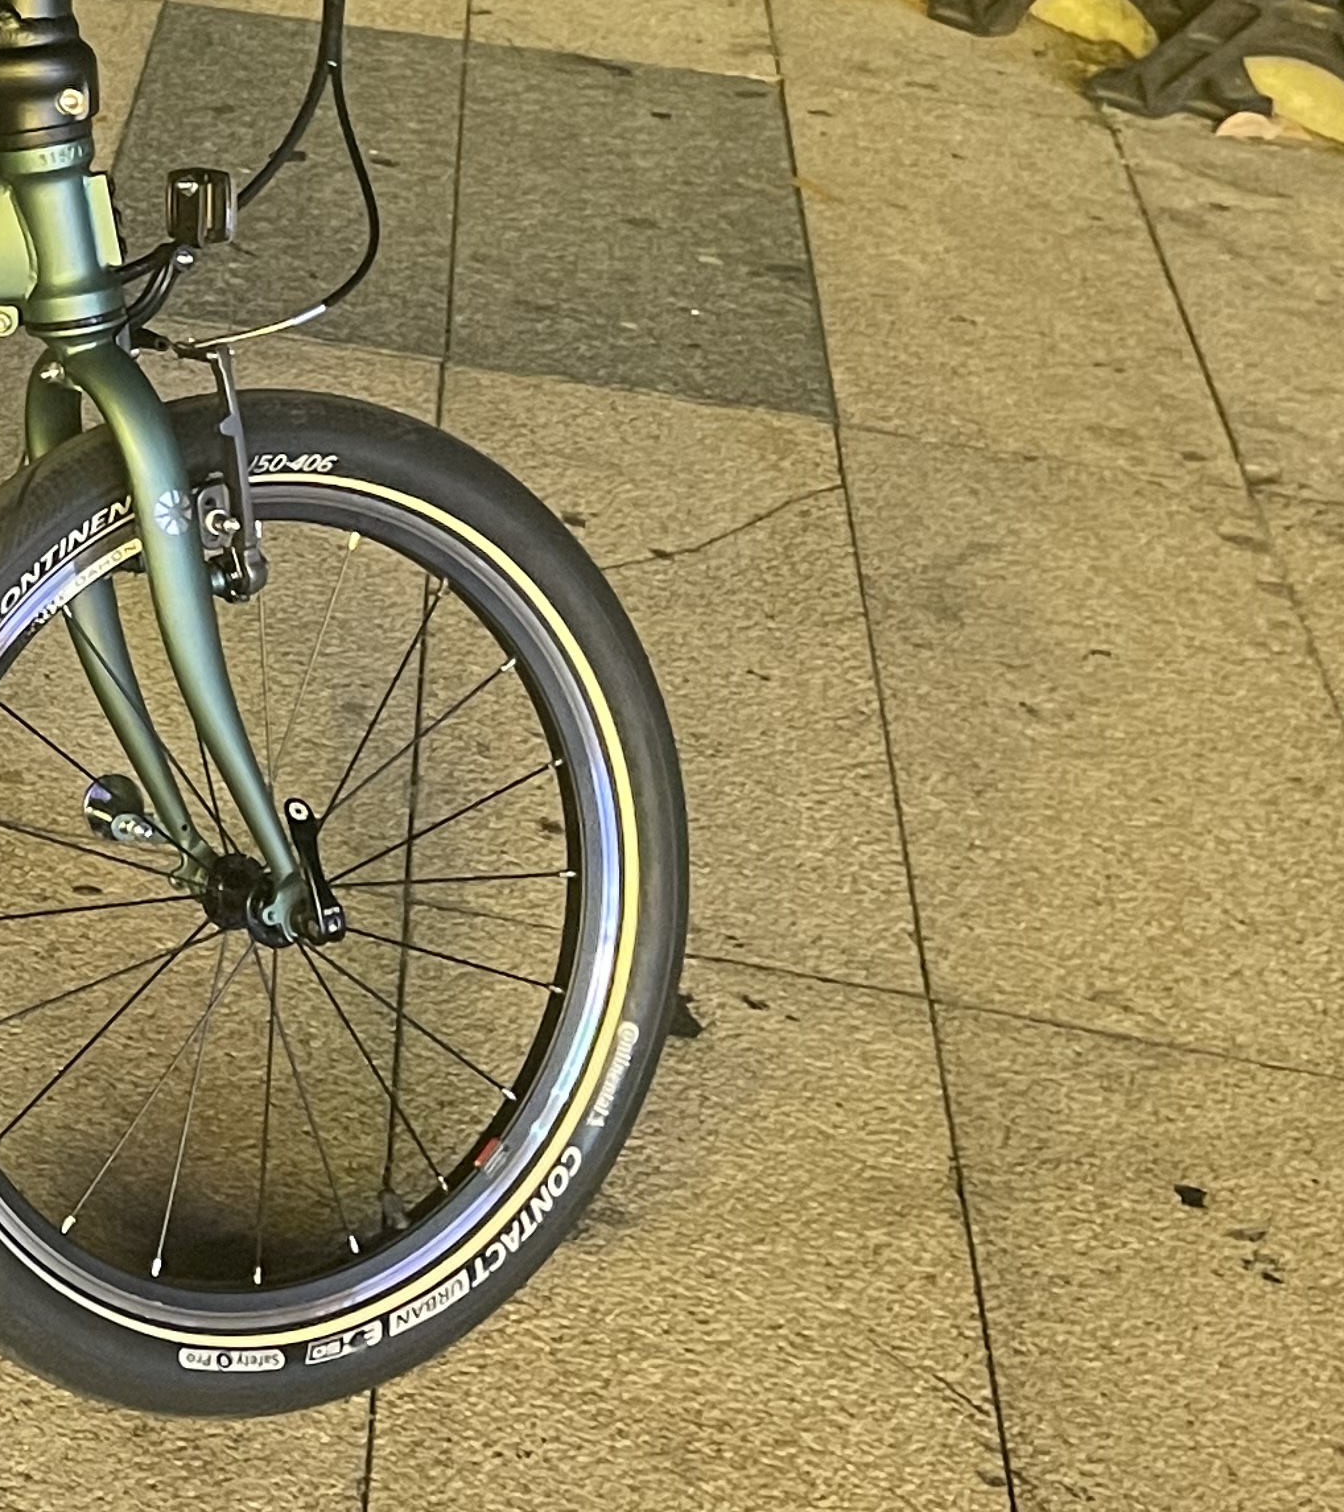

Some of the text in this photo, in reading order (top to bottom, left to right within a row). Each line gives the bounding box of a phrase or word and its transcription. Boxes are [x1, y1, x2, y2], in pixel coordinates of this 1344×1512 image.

[471, 1145, 582, 1288] CONTACT
[395, 1278, 464, 1329] URBAN
[186, 1353, 279, 1367] Safety Pro
